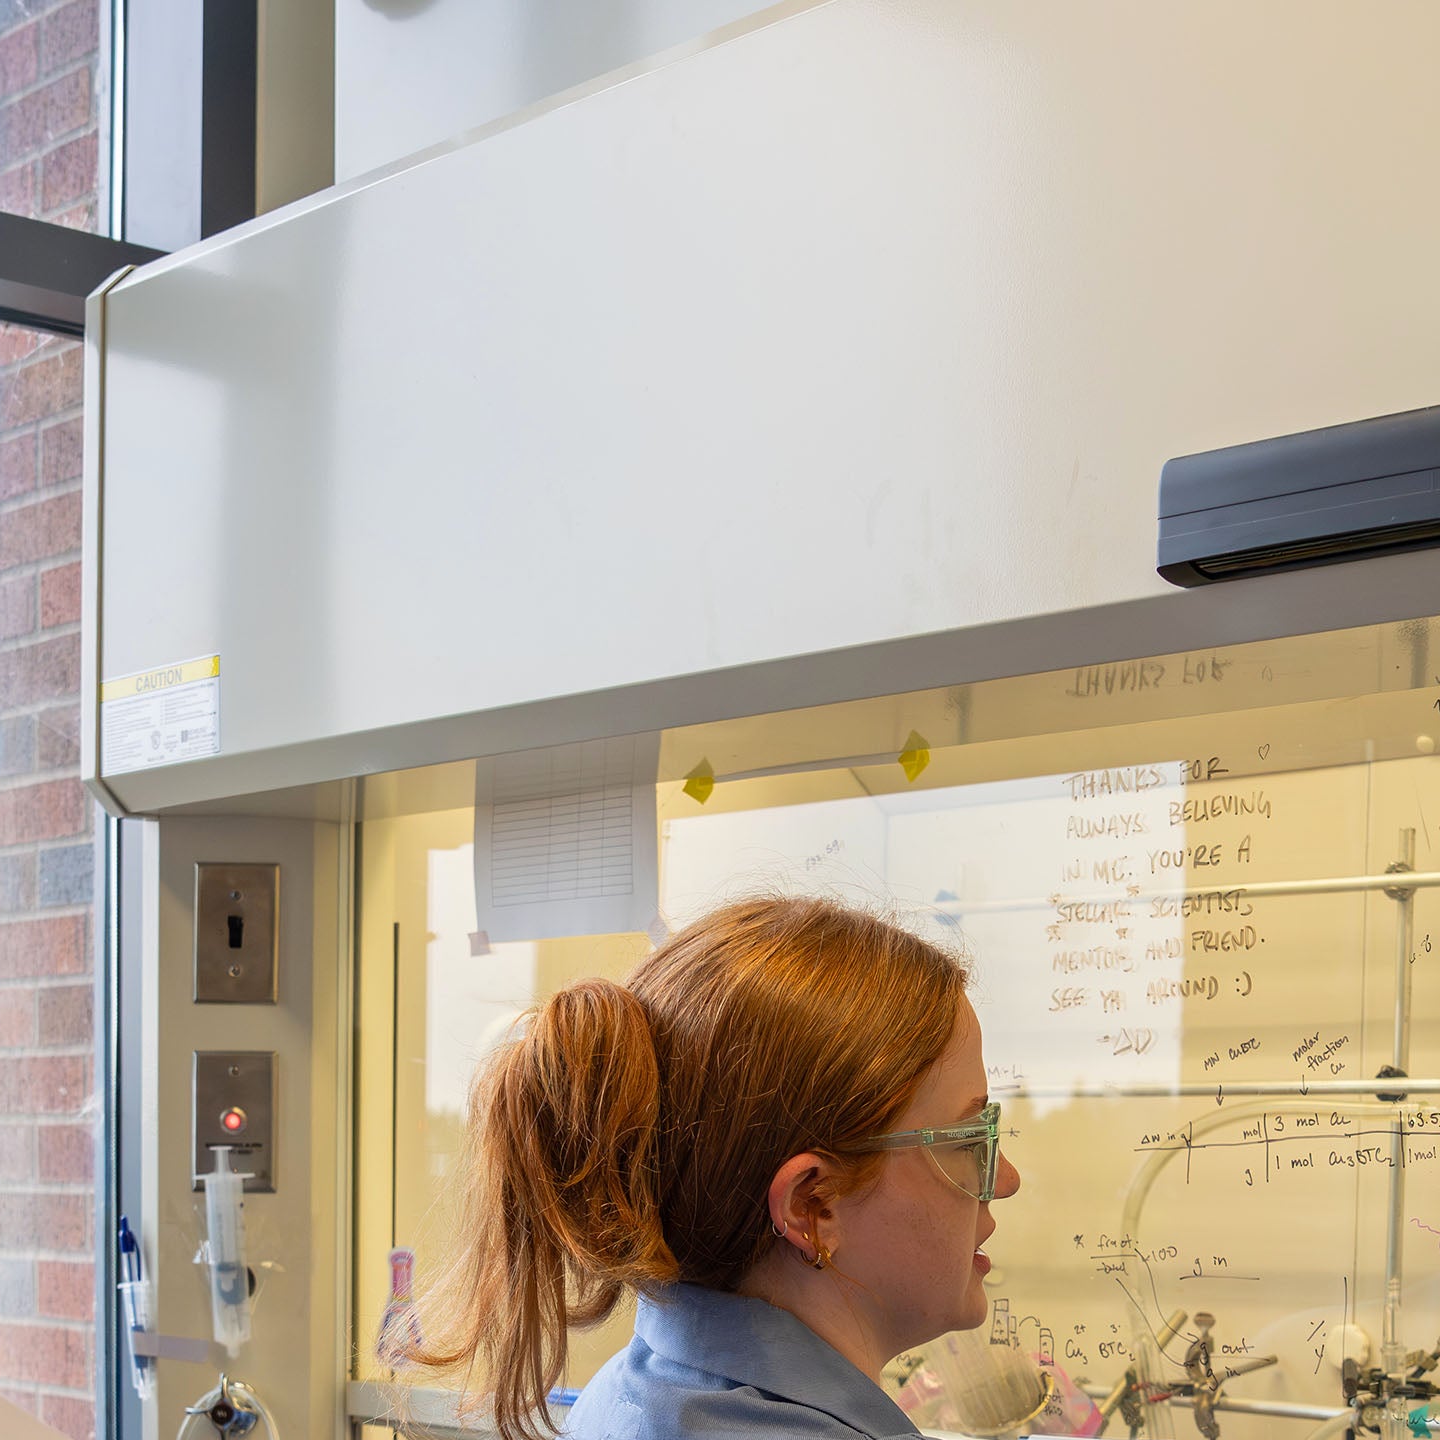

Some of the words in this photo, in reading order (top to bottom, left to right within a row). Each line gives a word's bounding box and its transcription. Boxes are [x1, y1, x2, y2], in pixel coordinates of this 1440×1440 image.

[136, 668, 182, 692] CAUTION
[1062, 766, 1167, 801] THANKS
[1179, 757, 1229, 785] FOR
[1169, 791, 1271, 826] BELIEVING
[1238, 835, 1251, 862] A
[1292, 1032, 1320, 1062] molar
[1306, 1035, 1350, 1071] fraction
[1274, 1116, 1285, 1132] 3
[1296, 1113, 1320, 1127] mol
[1291, 1152, 1314, 1168] mol
